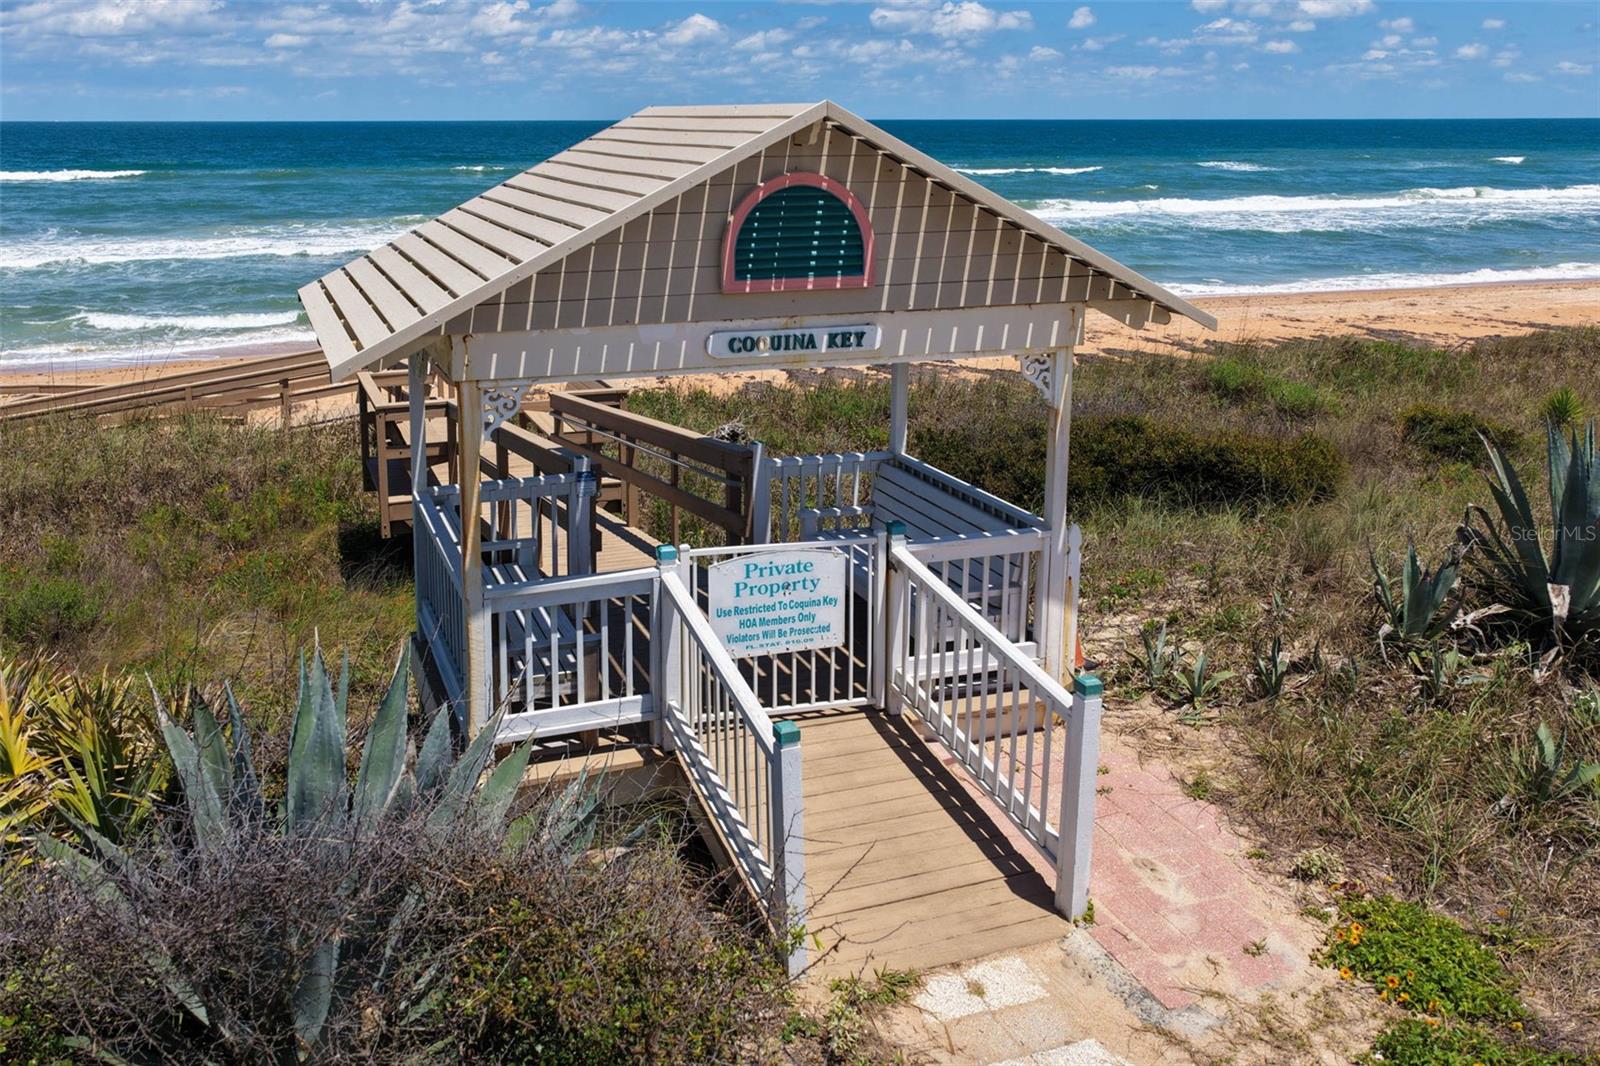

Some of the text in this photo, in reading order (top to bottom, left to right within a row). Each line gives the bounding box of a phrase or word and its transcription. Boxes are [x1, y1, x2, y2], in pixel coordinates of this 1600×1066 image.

[728, 331, 866, 354] COQUINA KEY
[745, 560, 814, 579] Private
[734, 577, 820, 598] Property
[716, 595, 838, 618] Use Restricted To Coquina Key
[739, 612, 816, 629] HOA Members Only
[727, 623, 831, 645] Violators Will Be Prosecuted
